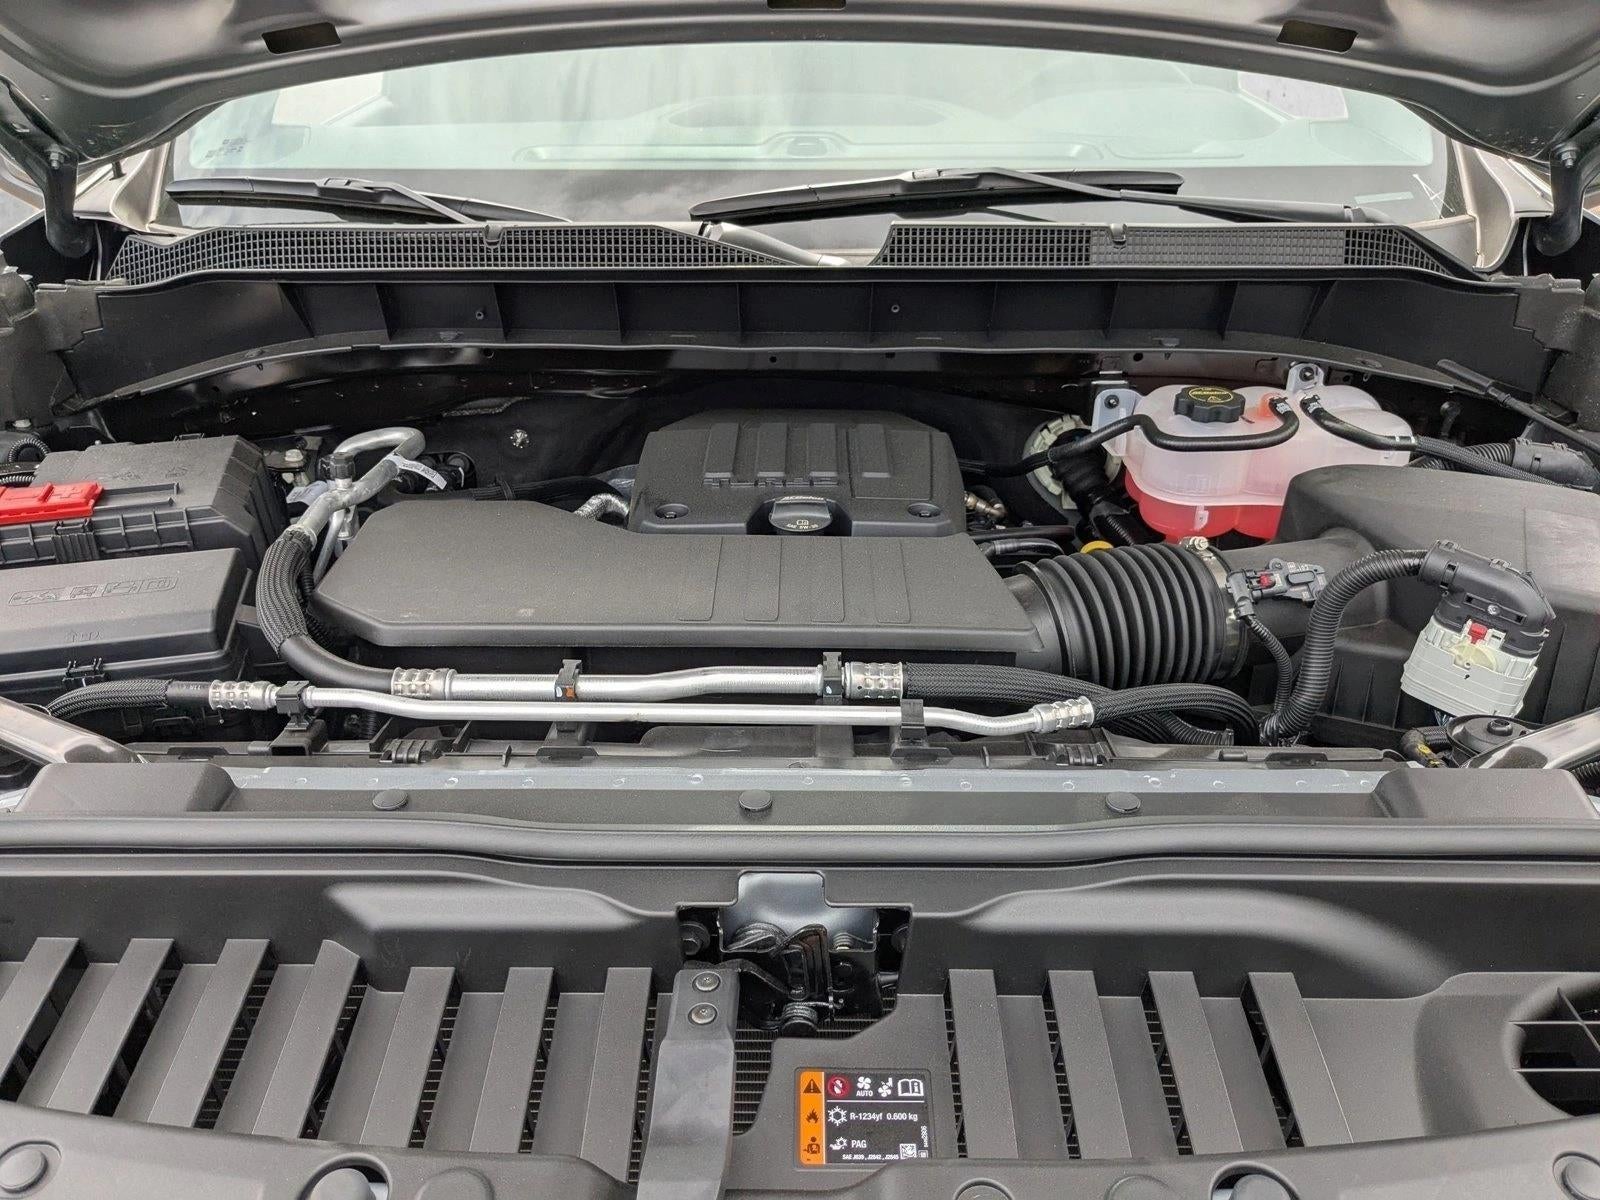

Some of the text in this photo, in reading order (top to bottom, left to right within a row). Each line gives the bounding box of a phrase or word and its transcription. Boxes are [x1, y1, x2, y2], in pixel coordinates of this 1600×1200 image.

[850, 1111, 918, 1122] R-1234yf 0.600 kg
[851, 1139, 867, 1148] PAG
